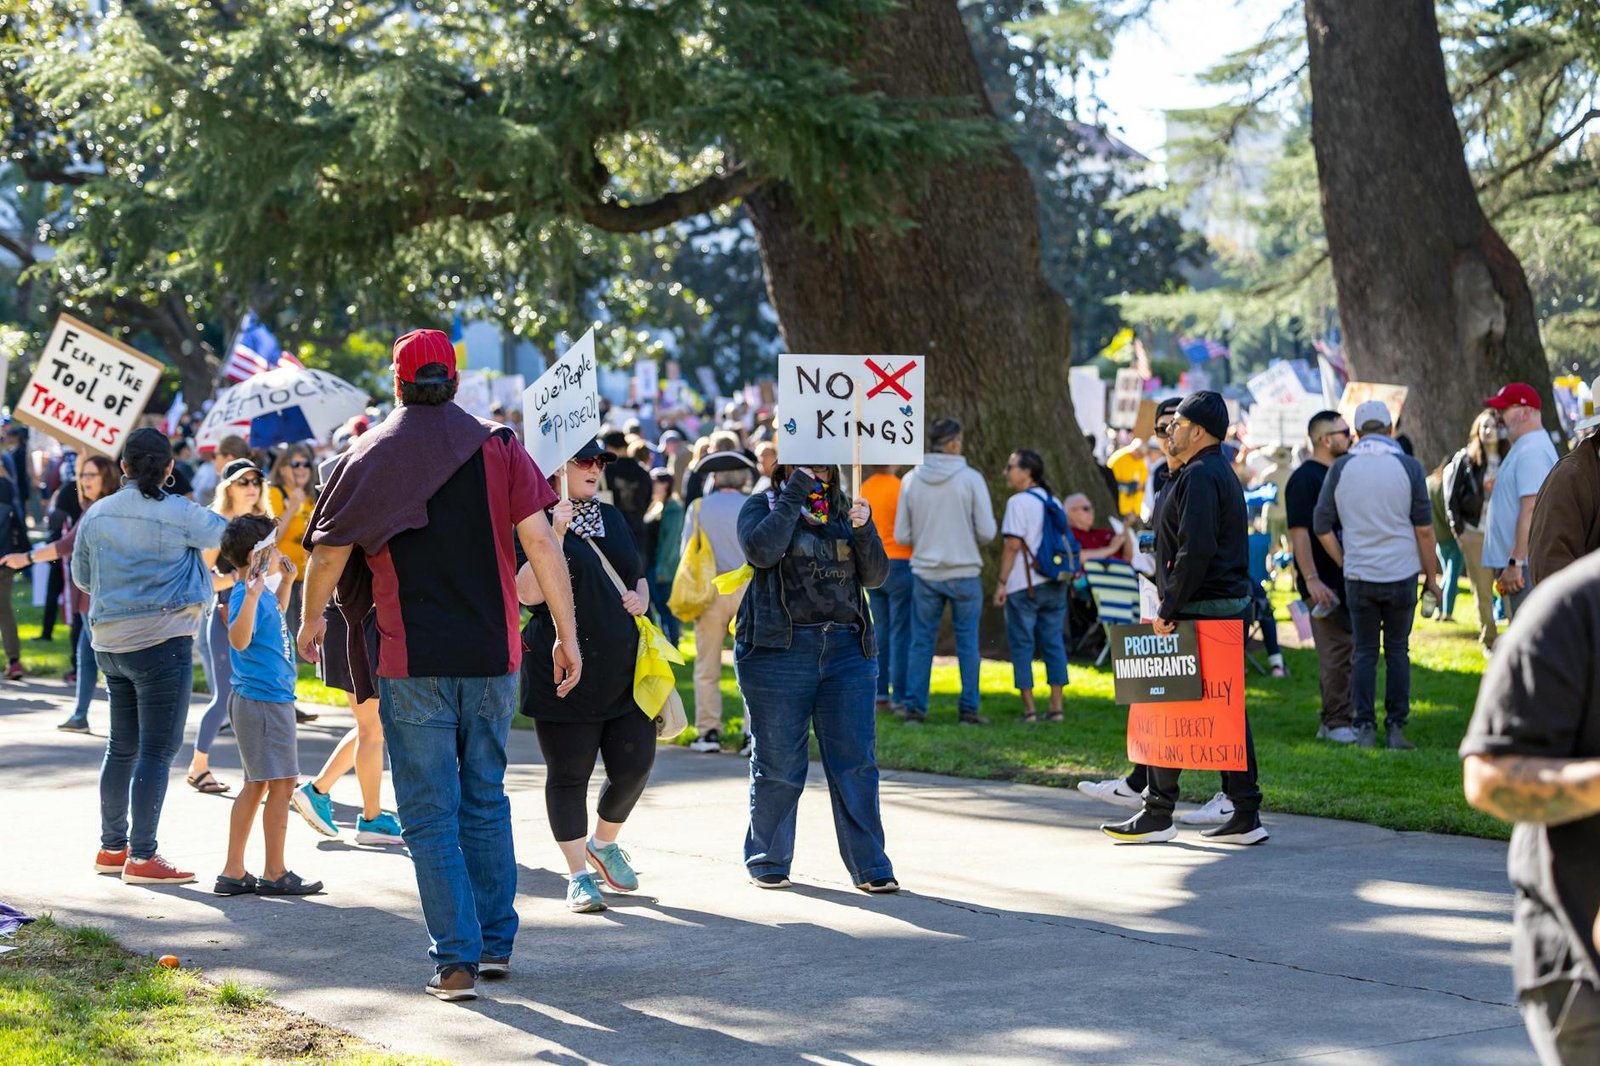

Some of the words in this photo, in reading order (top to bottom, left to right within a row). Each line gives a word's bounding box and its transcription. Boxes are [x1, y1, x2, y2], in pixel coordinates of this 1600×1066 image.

[51, 358, 99, 402] TOOL
[104, 395, 133, 416] OF
[535, 386, 560, 411] We
[562, 353, 593, 391] People
[796, 366, 854, 401] NO
[33, 382, 120, 446] TYRANTS
[808, 561, 849, 586] King
[1124, 633, 1180, 656] PROTECT
[1115, 654, 1197, 680] IMMIGRANTS
[1164, 715, 1215, 739] LIBERTY
[1158, 742, 1184, 763] LONG
